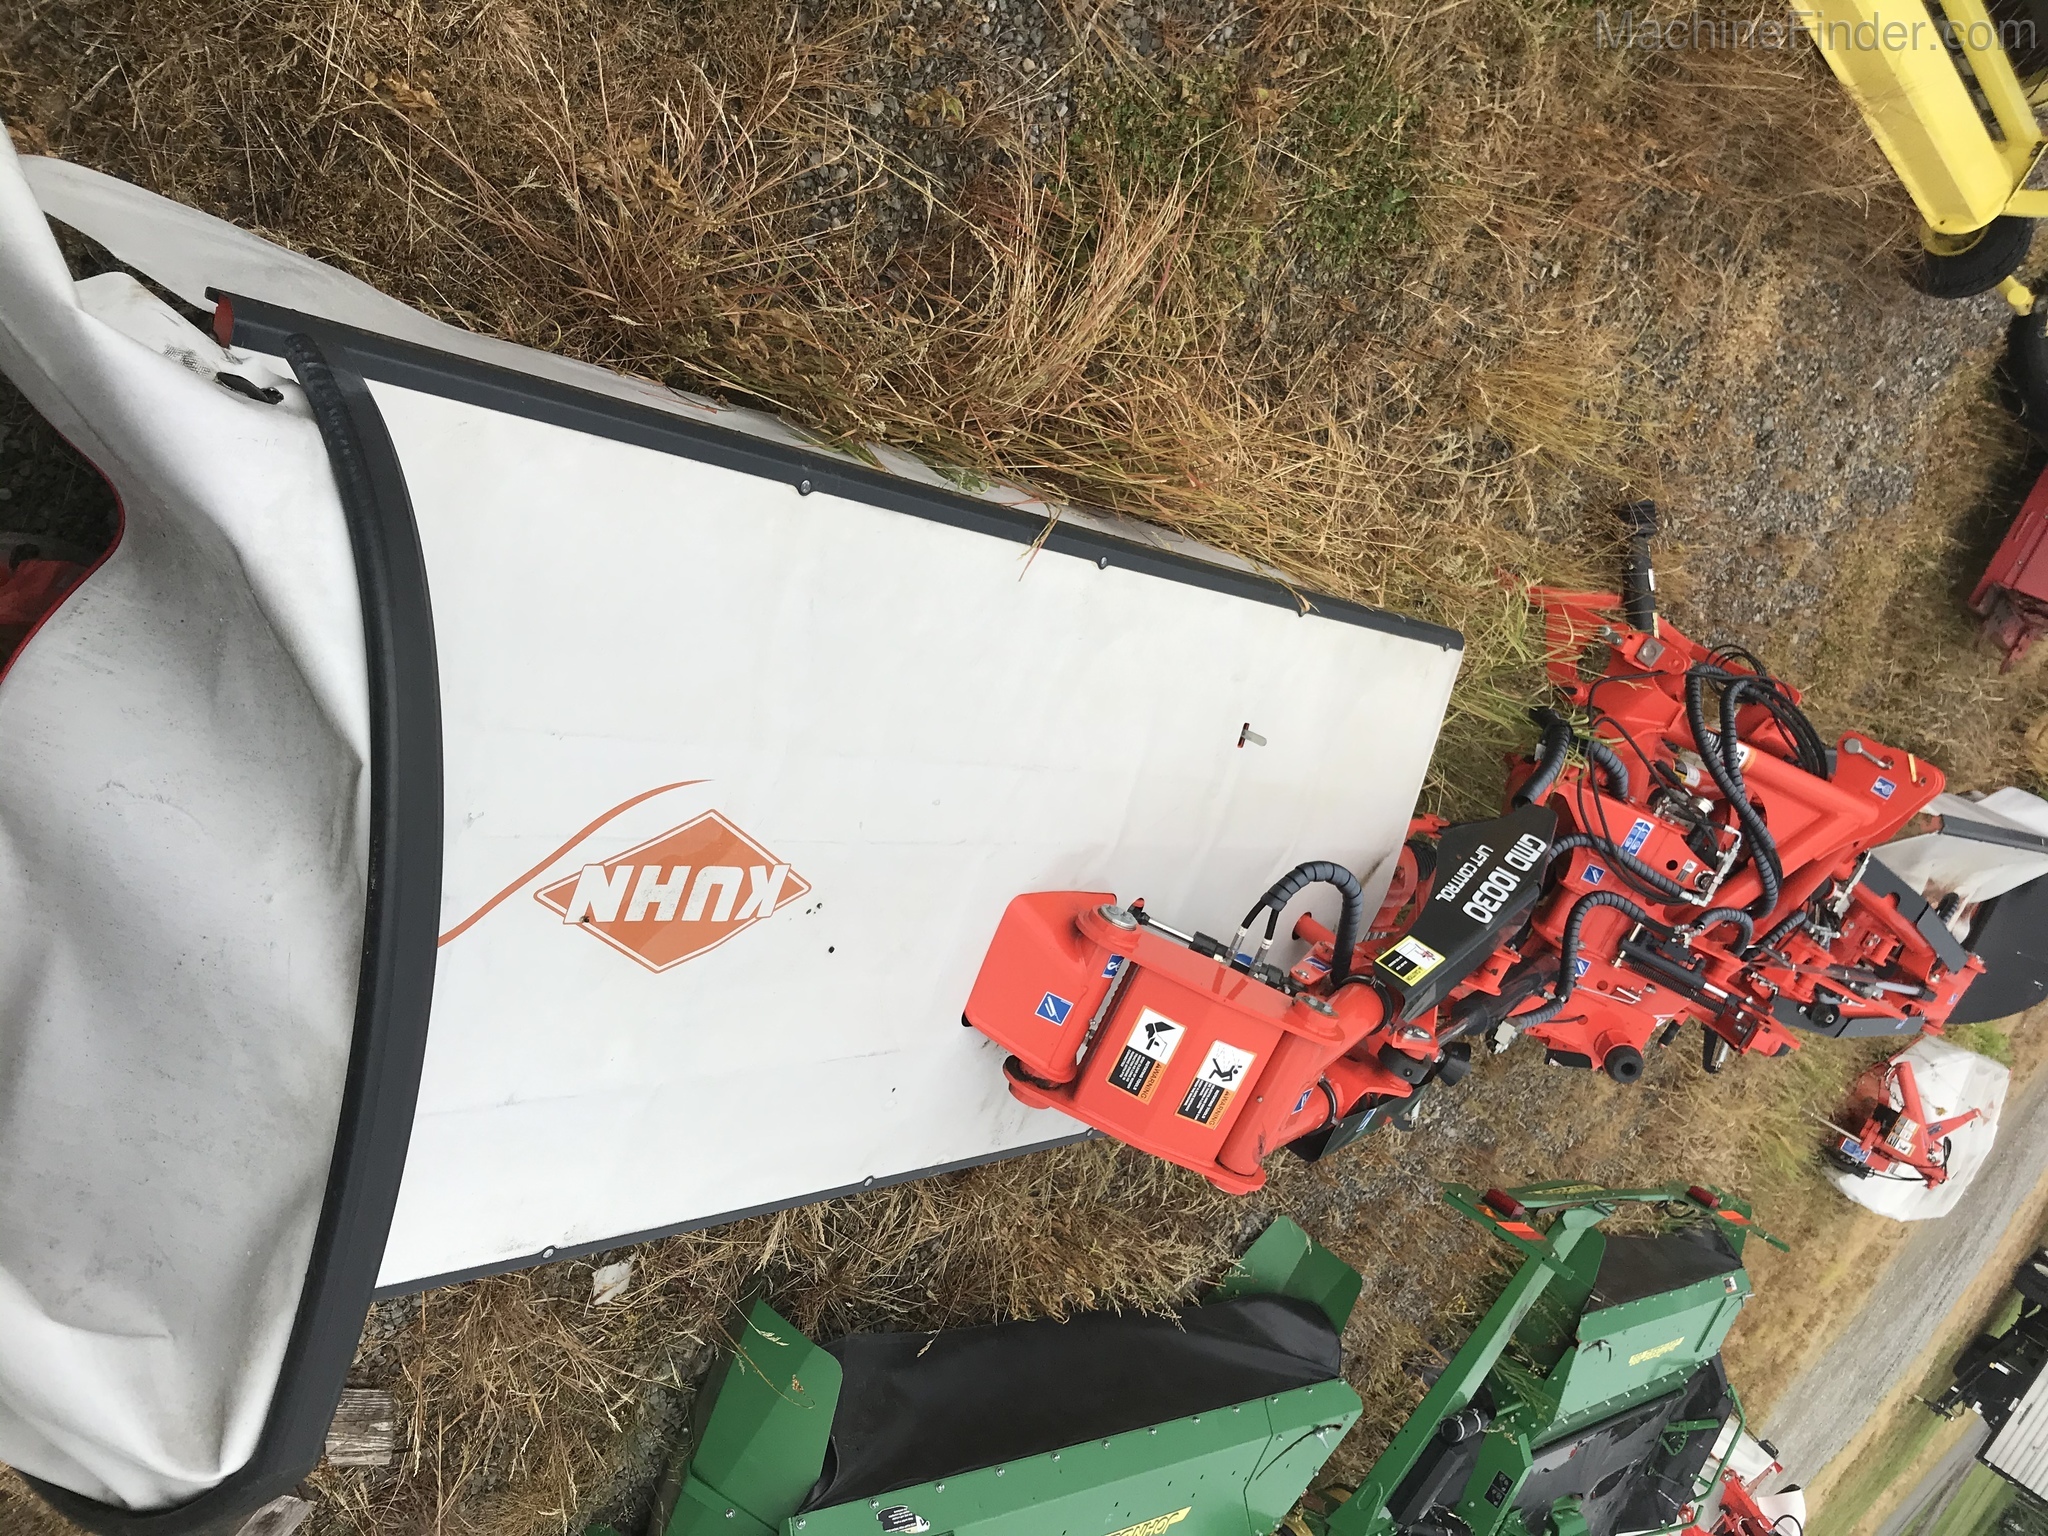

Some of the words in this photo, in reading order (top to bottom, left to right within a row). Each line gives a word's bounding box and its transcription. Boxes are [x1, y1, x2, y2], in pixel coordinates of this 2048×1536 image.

[1470, 844, 1494, 867] LIFT
[1504, 833, 1547, 872] GMD
[563, 864, 791, 924] KUHN
[1435, 864, 1478, 902] CONTROL
[1462, 866, 1521, 924] 10030
[1141, 1068, 1161, 1099] WARNING
[1208, 1095, 1229, 1126] WARNING
